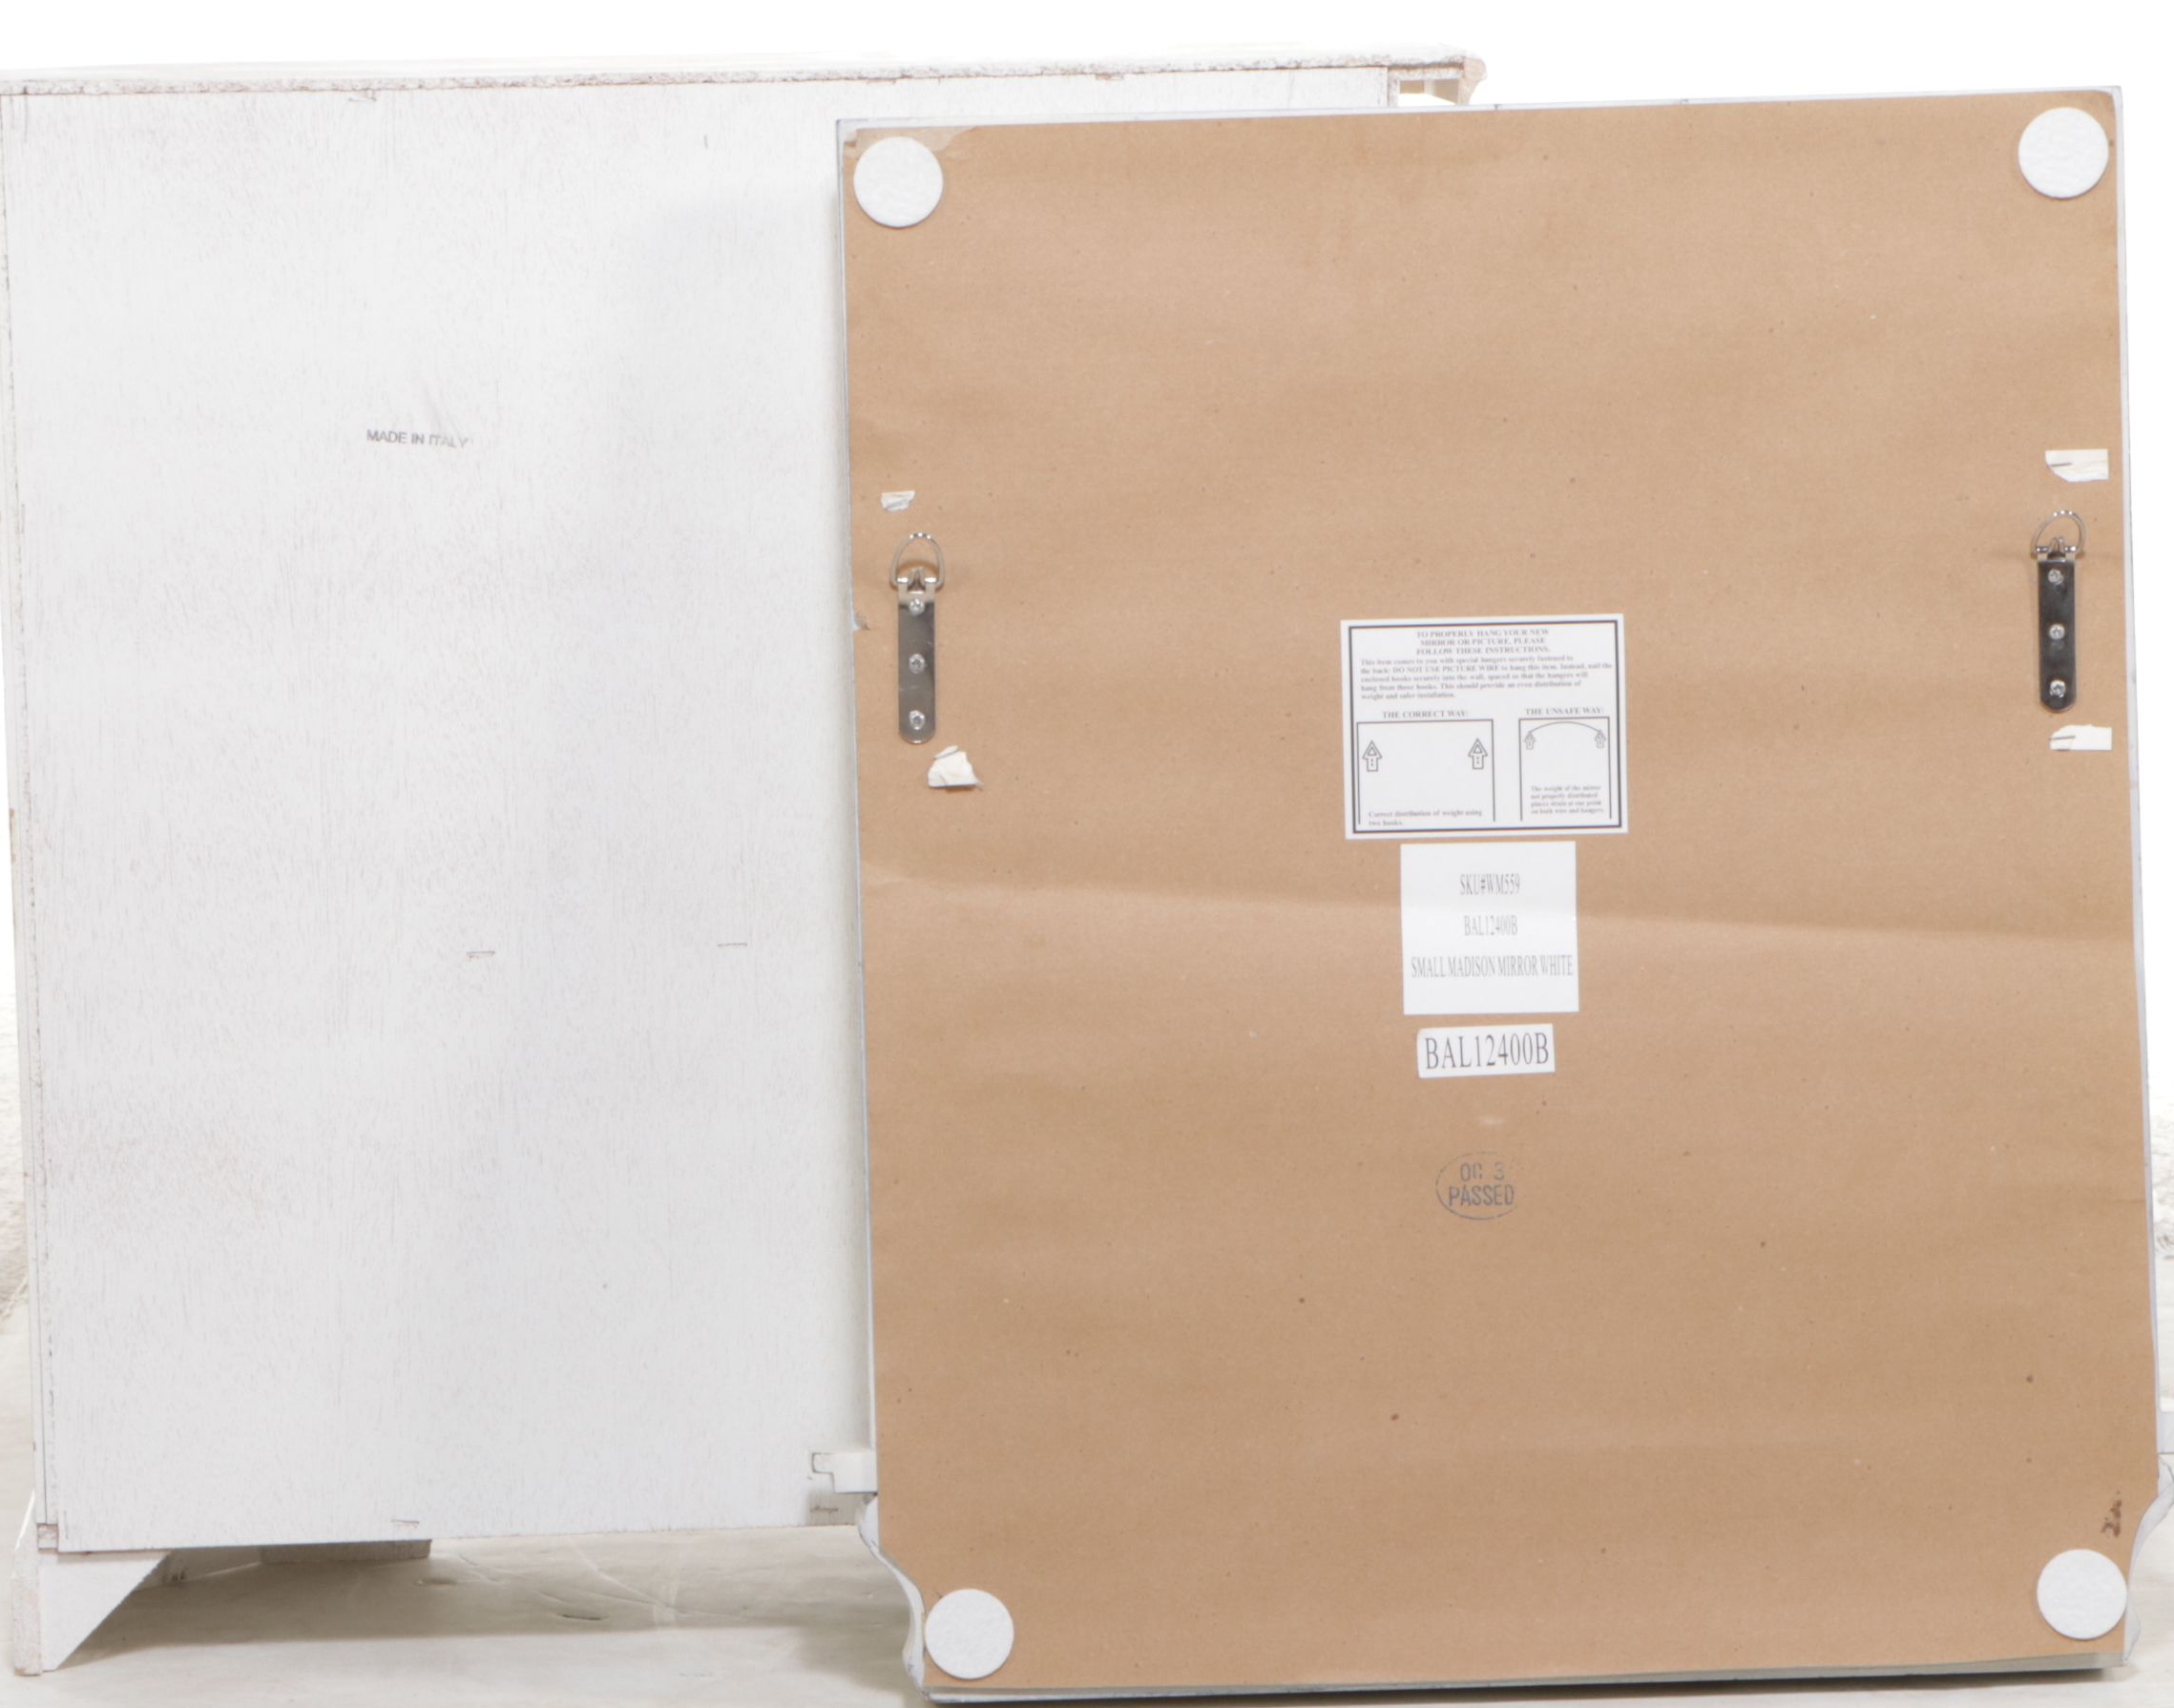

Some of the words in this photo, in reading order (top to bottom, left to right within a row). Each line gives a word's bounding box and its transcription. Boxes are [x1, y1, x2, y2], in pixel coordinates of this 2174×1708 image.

[366, 429, 408, 445] MADE
[410, 432, 425, 446] IN
[429, 433, 469, 448] ITALY
[1442, 664, 1475, 673] PICTURE
[1510, 663, 1526, 673] hang
[1480, 656, 1507, 665] hangers
[1402, 710, 1445, 719] CORRECT
[1459, 872, 1520, 896] SKU#WM559
[1464, 914, 1518, 937] BAL12400B
[1411, 955, 1447, 979] SMALL
[1448, 955, 1495, 978] MADISON
[1497, 954, 1538, 977] MIRROR
[1539, 953, 1574, 977] WHITE
[1425, 1031, 1550, 1071] BAL12400B
[1449, 1183, 1516, 1207] PASSED
